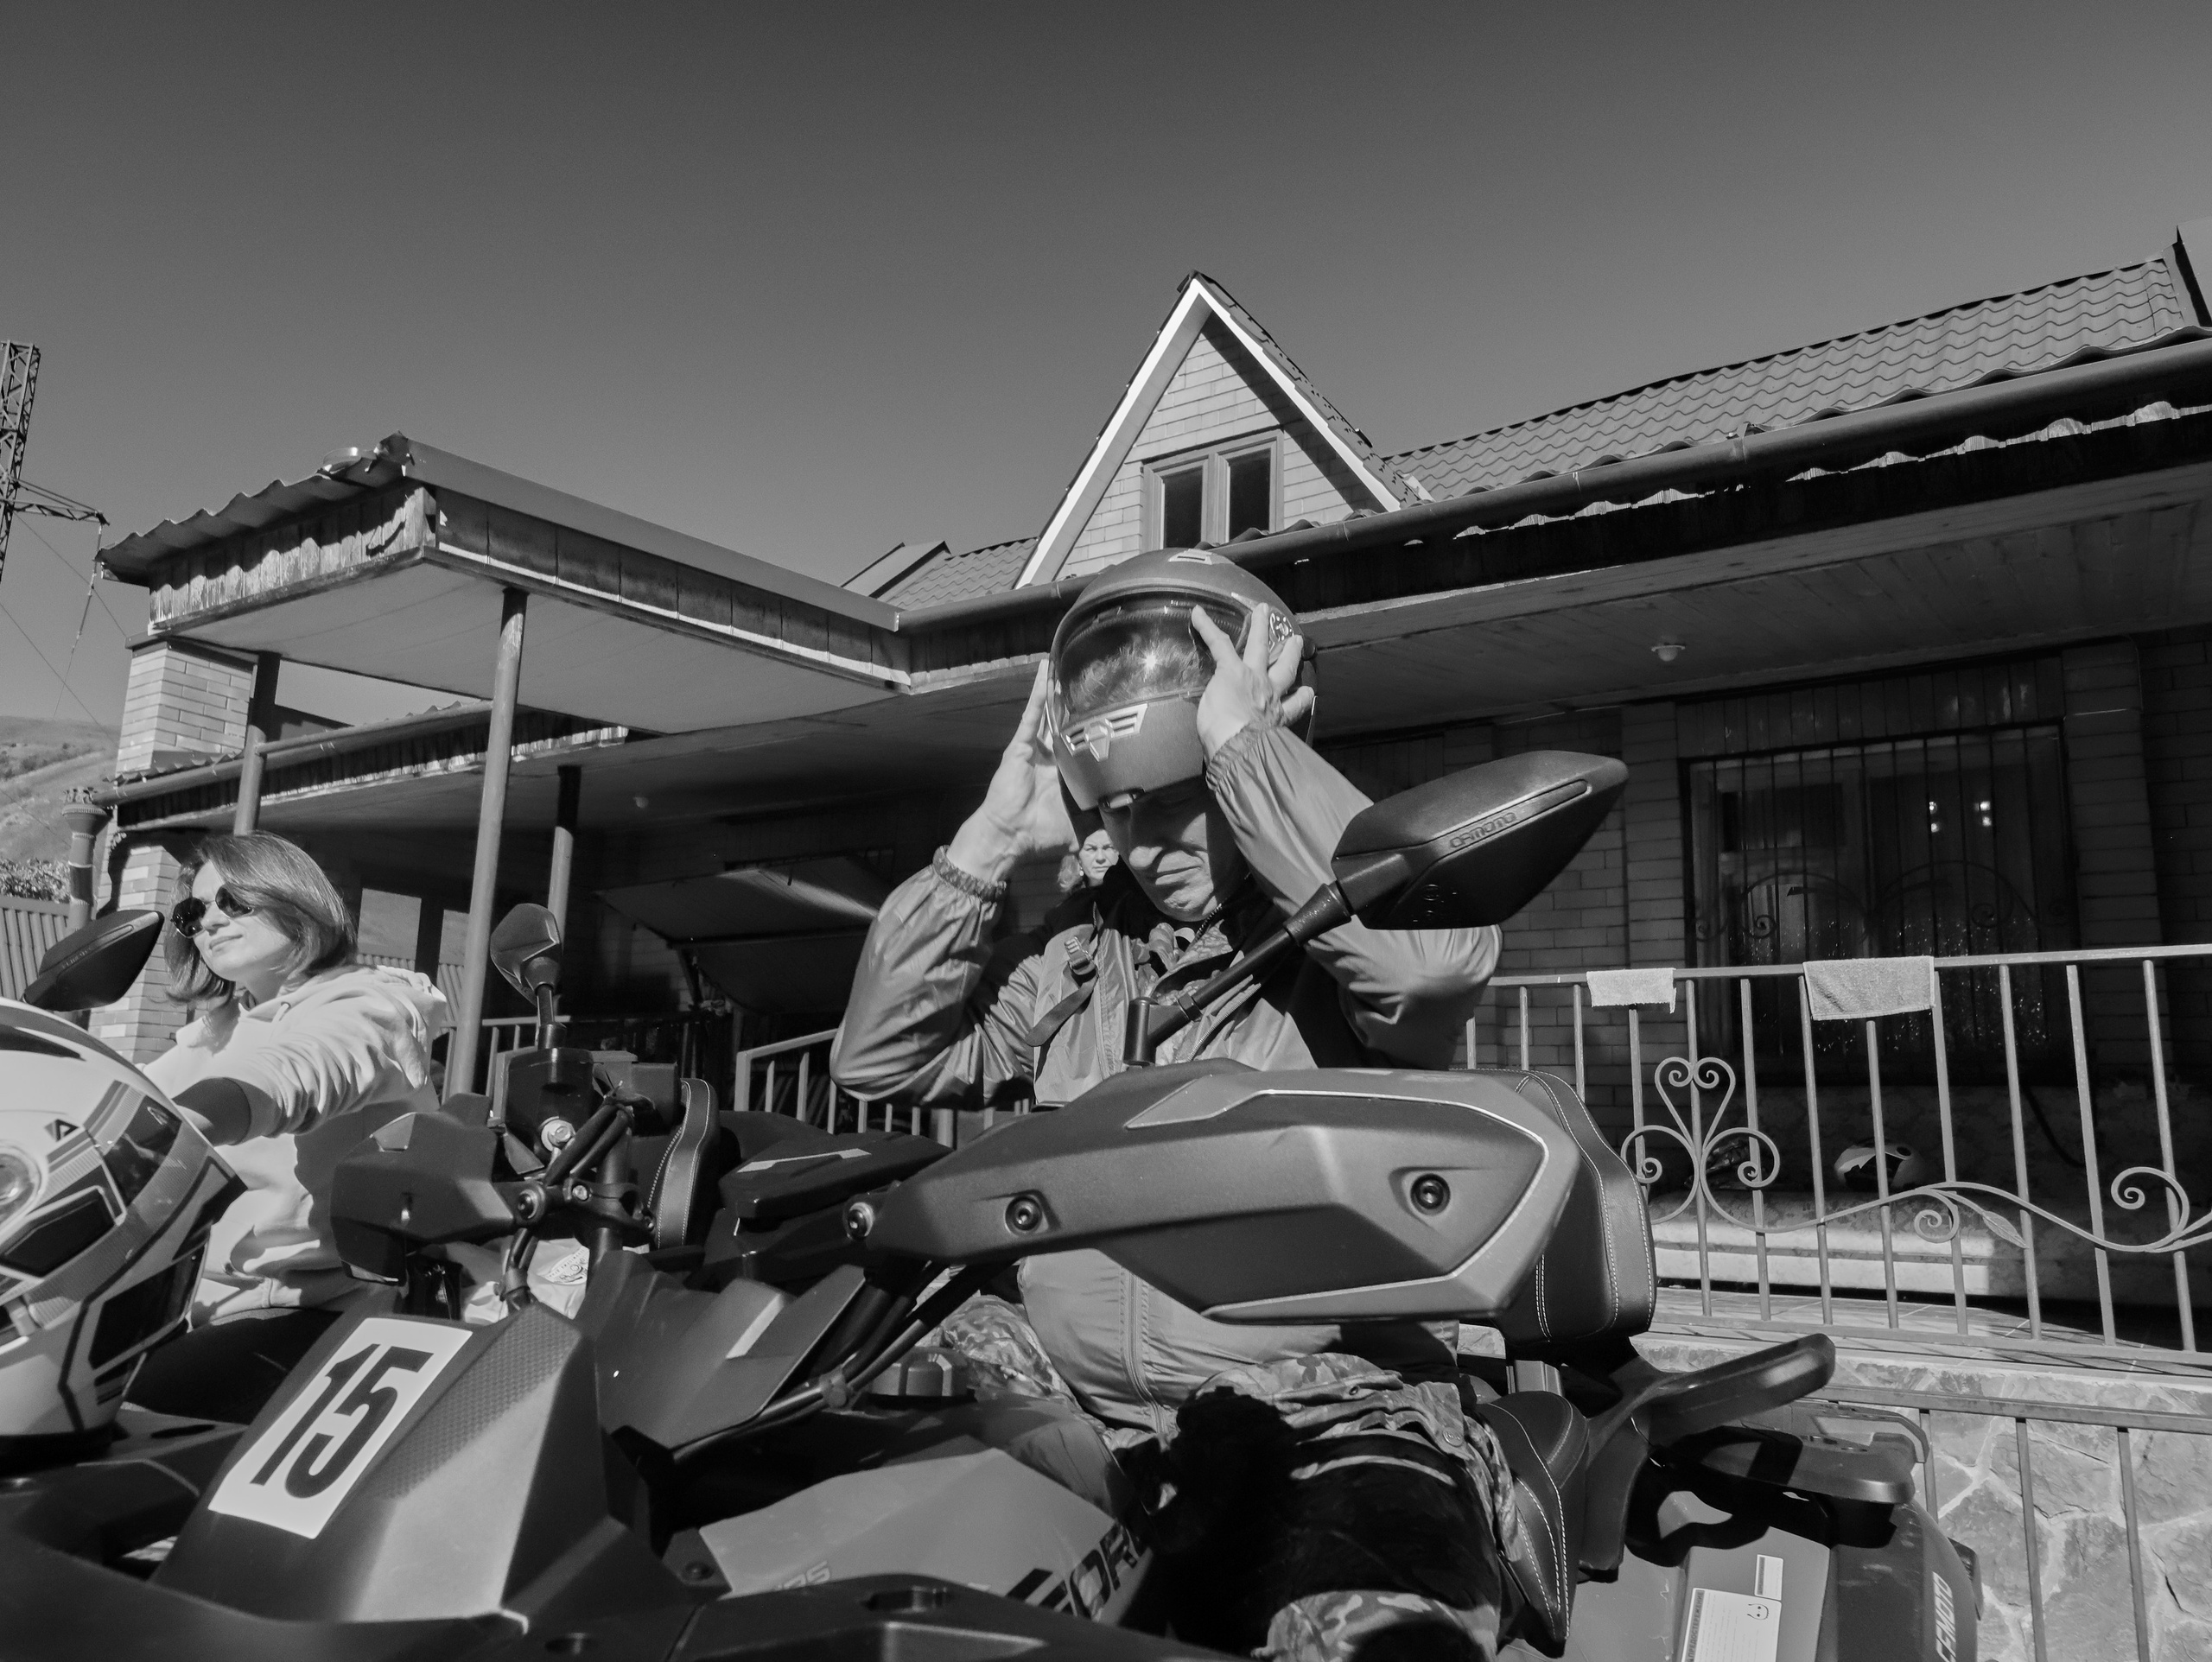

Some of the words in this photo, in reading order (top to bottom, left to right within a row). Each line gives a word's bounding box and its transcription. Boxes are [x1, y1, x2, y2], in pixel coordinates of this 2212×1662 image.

[249, 1343, 434, 1498] 15
[1688, 1591, 1704, 1658] ПРЕДОСТЕРЕЖЕНИЕ
[1932, 1571, 1956, 1662] CFMOTO
